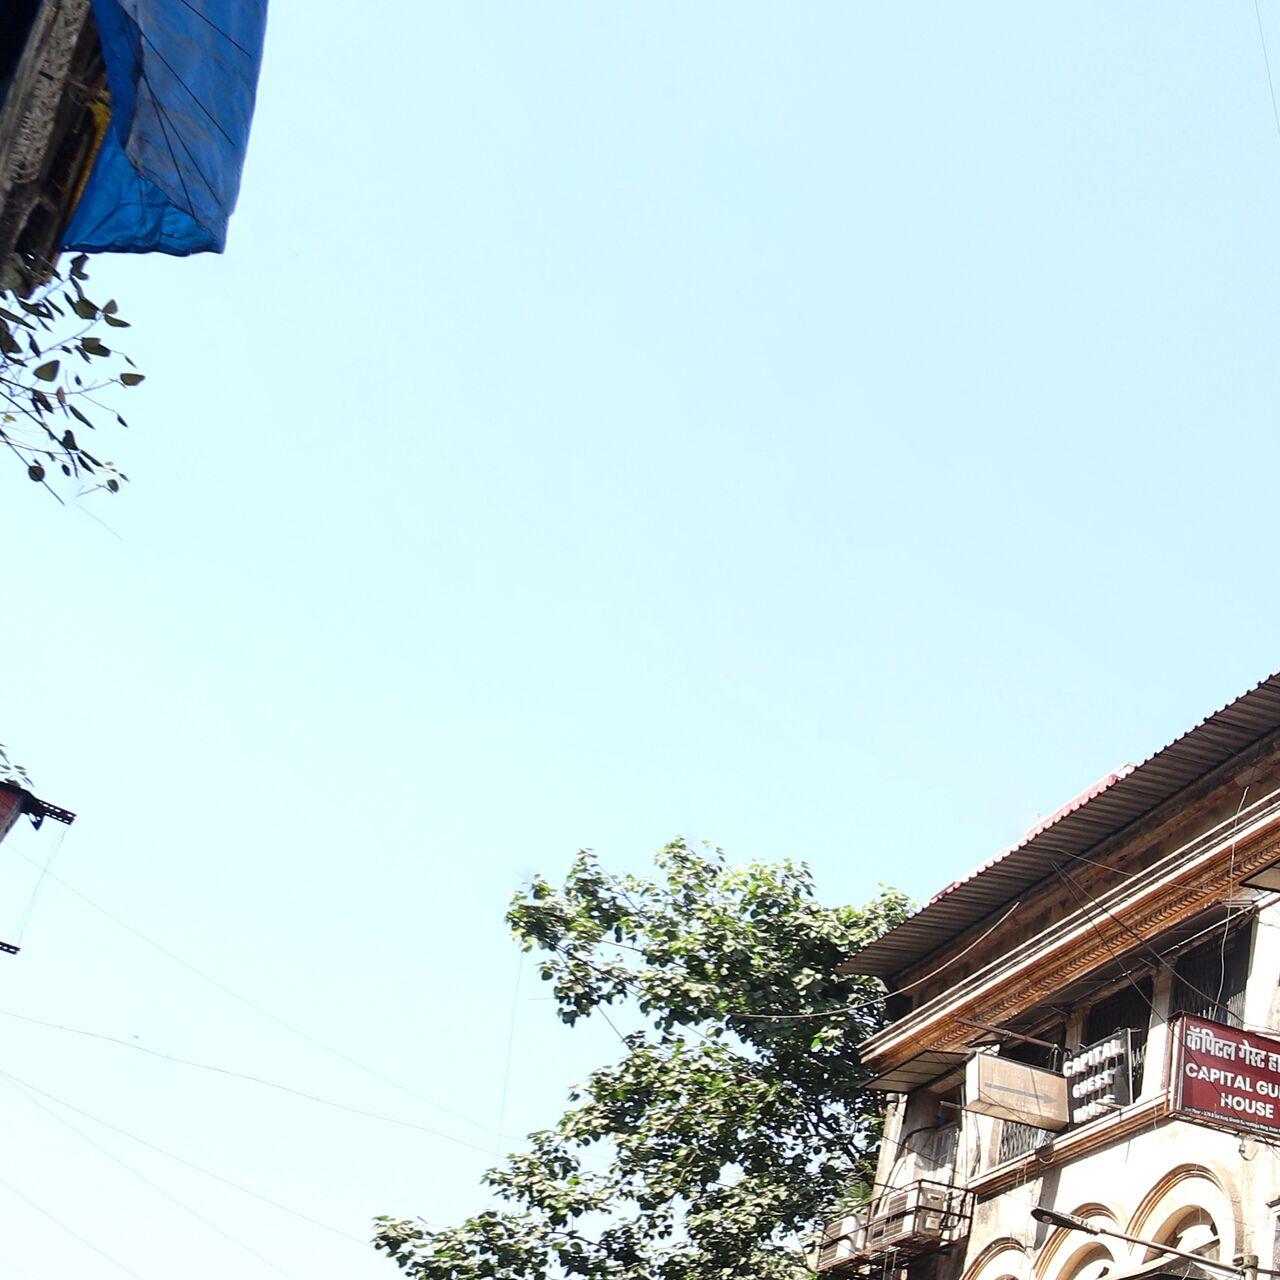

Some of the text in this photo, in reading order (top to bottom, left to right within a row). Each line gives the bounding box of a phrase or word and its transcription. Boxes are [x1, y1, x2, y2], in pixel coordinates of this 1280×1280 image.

[1063, 1039, 1126, 1077] CAPITAL
[1186, 1025, 1236, 1061] कॅपिटल
[1239, 1040, 1266, 1069] गेस्ट
[1072, 1068, 1116, 1099] GUEST
[1185, 1063, 1253, 1092] CAPITAL
[1220, 1092, 1274, 1119] HOUSE
